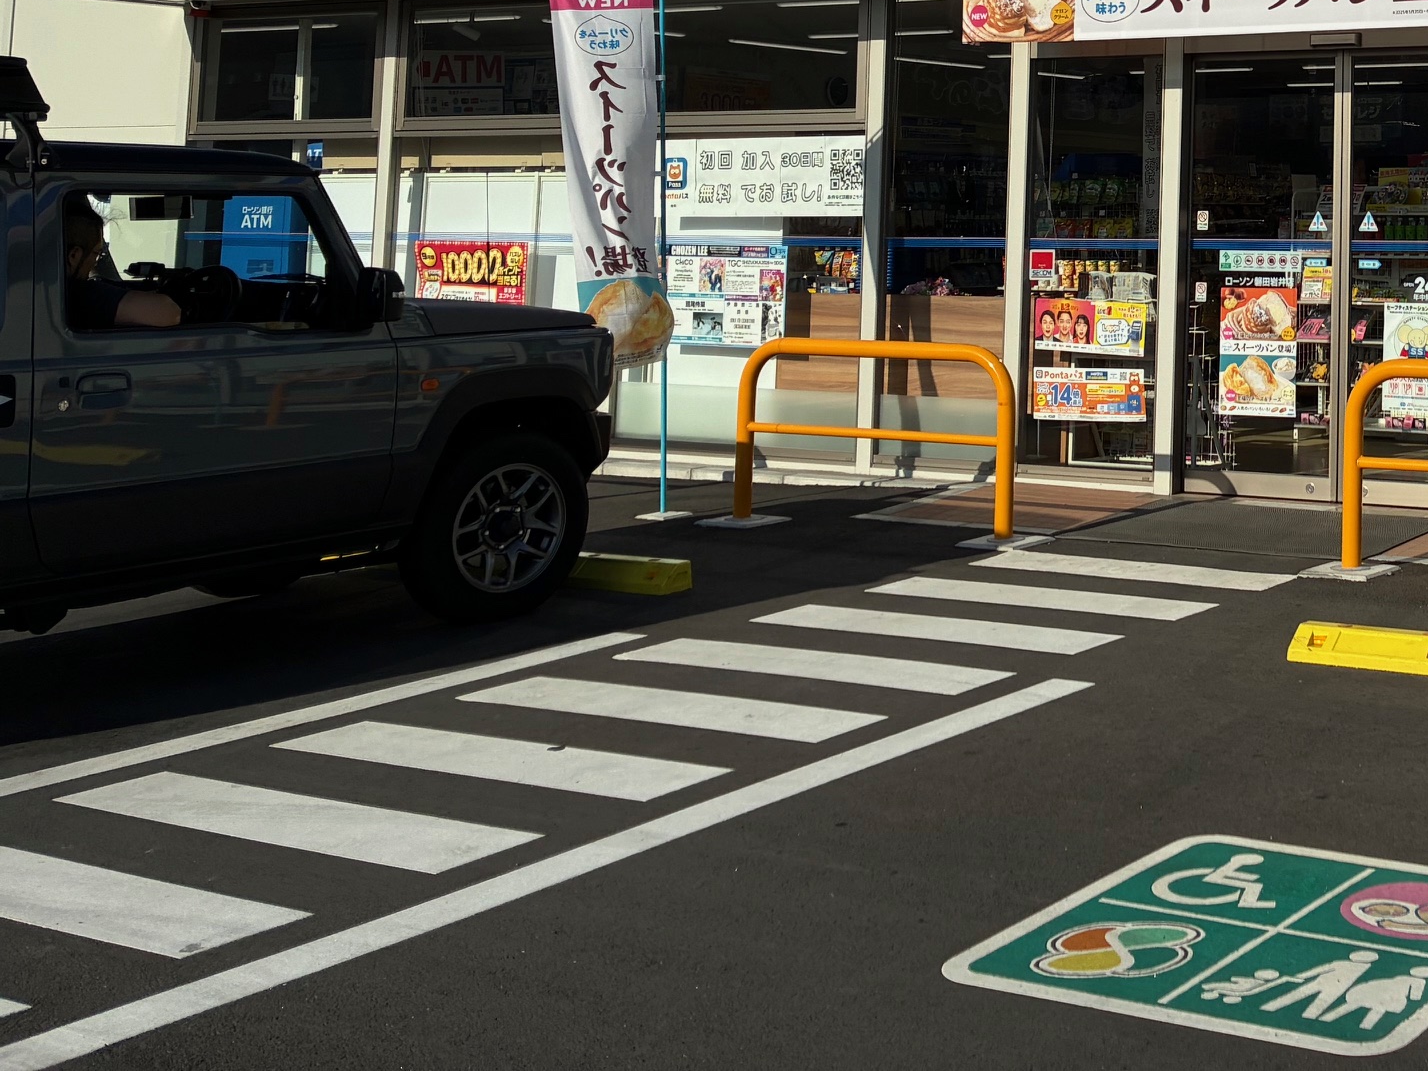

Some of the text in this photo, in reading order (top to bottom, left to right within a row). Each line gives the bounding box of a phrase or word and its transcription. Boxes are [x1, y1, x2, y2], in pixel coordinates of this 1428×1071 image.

[1095, 2, 1127, 15] 味わう
[971, 12, 988, 21] NEW
[432, 54, 502, 84] ATM
[242, 206, 273, 214] ローソン銀行
[241, 215, 273, 228] ATM
[671, 245, 697, 256] CHOZEN
[698, 246, 709, 256] LEE
[728, 260, 742, 268] TGC
[497, 266, 522, 275] ポイント
[1410, 348, 1424, 356] SS
[1050, 383, 1072, 406] 14
